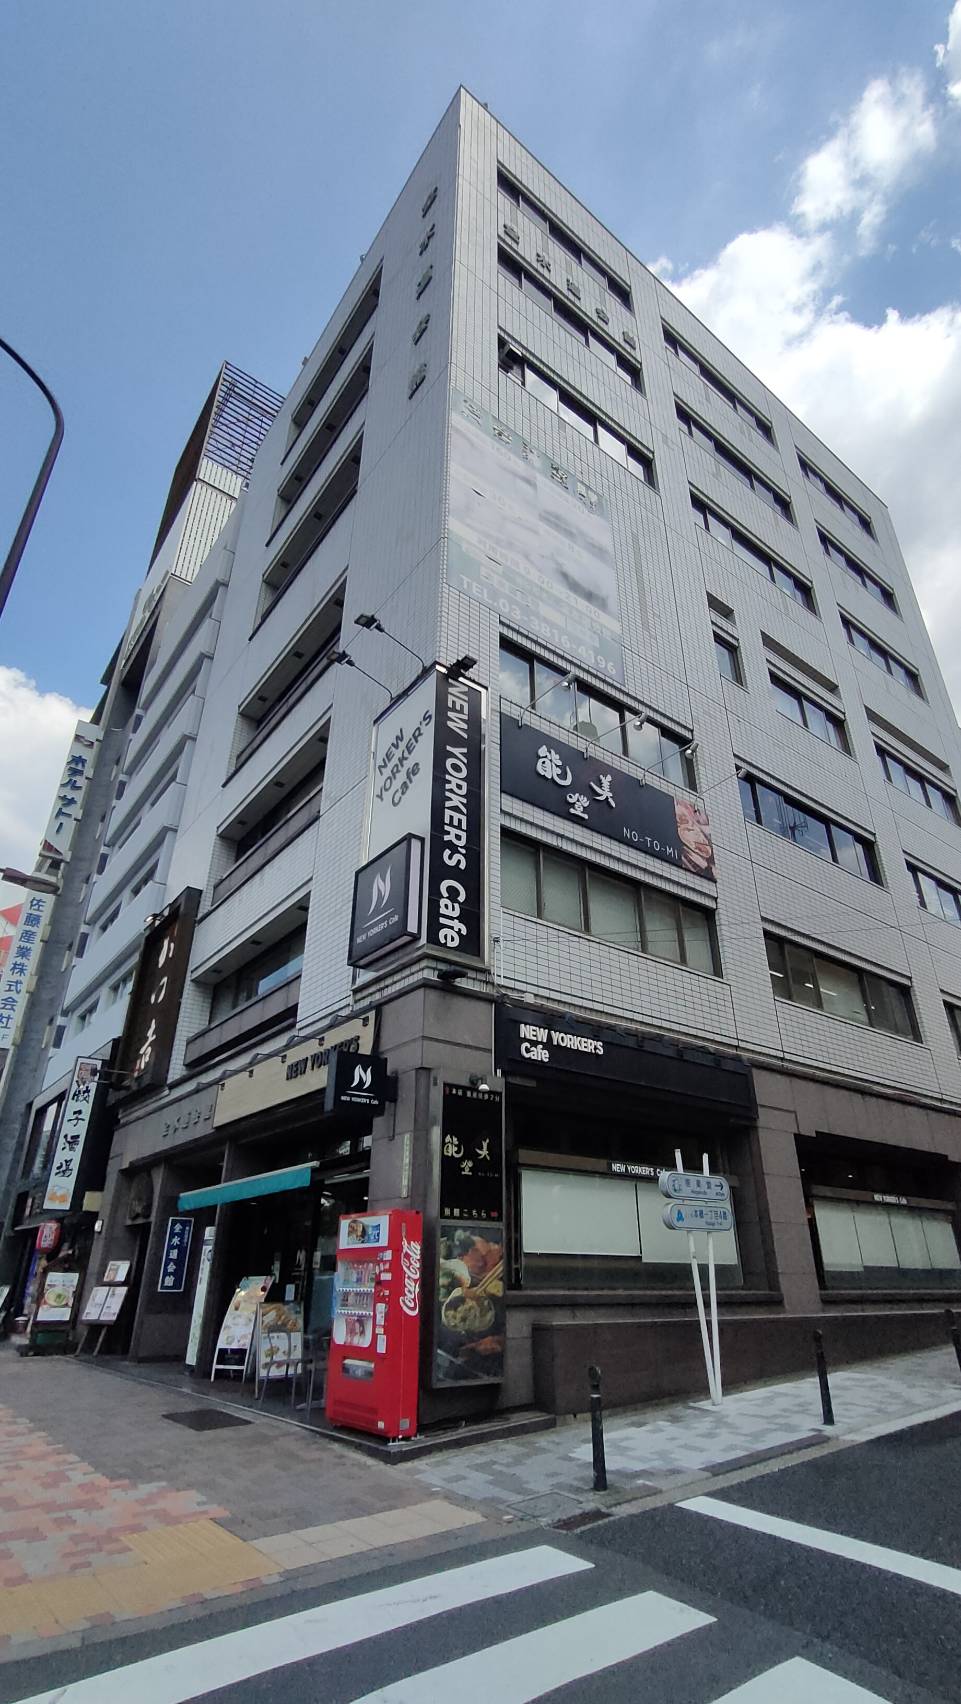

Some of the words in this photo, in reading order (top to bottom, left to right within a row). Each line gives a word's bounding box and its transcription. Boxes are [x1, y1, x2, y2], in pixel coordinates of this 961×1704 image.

[447, 677, 469, 740] NEW
[376, 710, 433, 802] YORKER'S
[377, 728, 405, 776] NEW
[55, 754, 87, 835] ホテルサトー
[391, 762, 420, 807] Cafe
[443, 745, 468, 870] YORKER'S
[623, 826, 678, 859] NO-TO-MI
[438, 880, 467, 948] Cafe
[0, 897, 46, 1030] 佐藤産業株式会社
[286, 1056, 309, 1080] NEW
[520, 1023, 548, 1043] NEW
[550, 1030, 604, 1055] YORKER'S
[520, 1042, 550, 1062] Cafe
[55, 1080, 91, 1178] 餃子酒場
[611, 1162, 626, 1173] NEW
[627, 1164, 654, 1177] YORKER'S
[163, 1222, 184, 1287] 全水道会館
